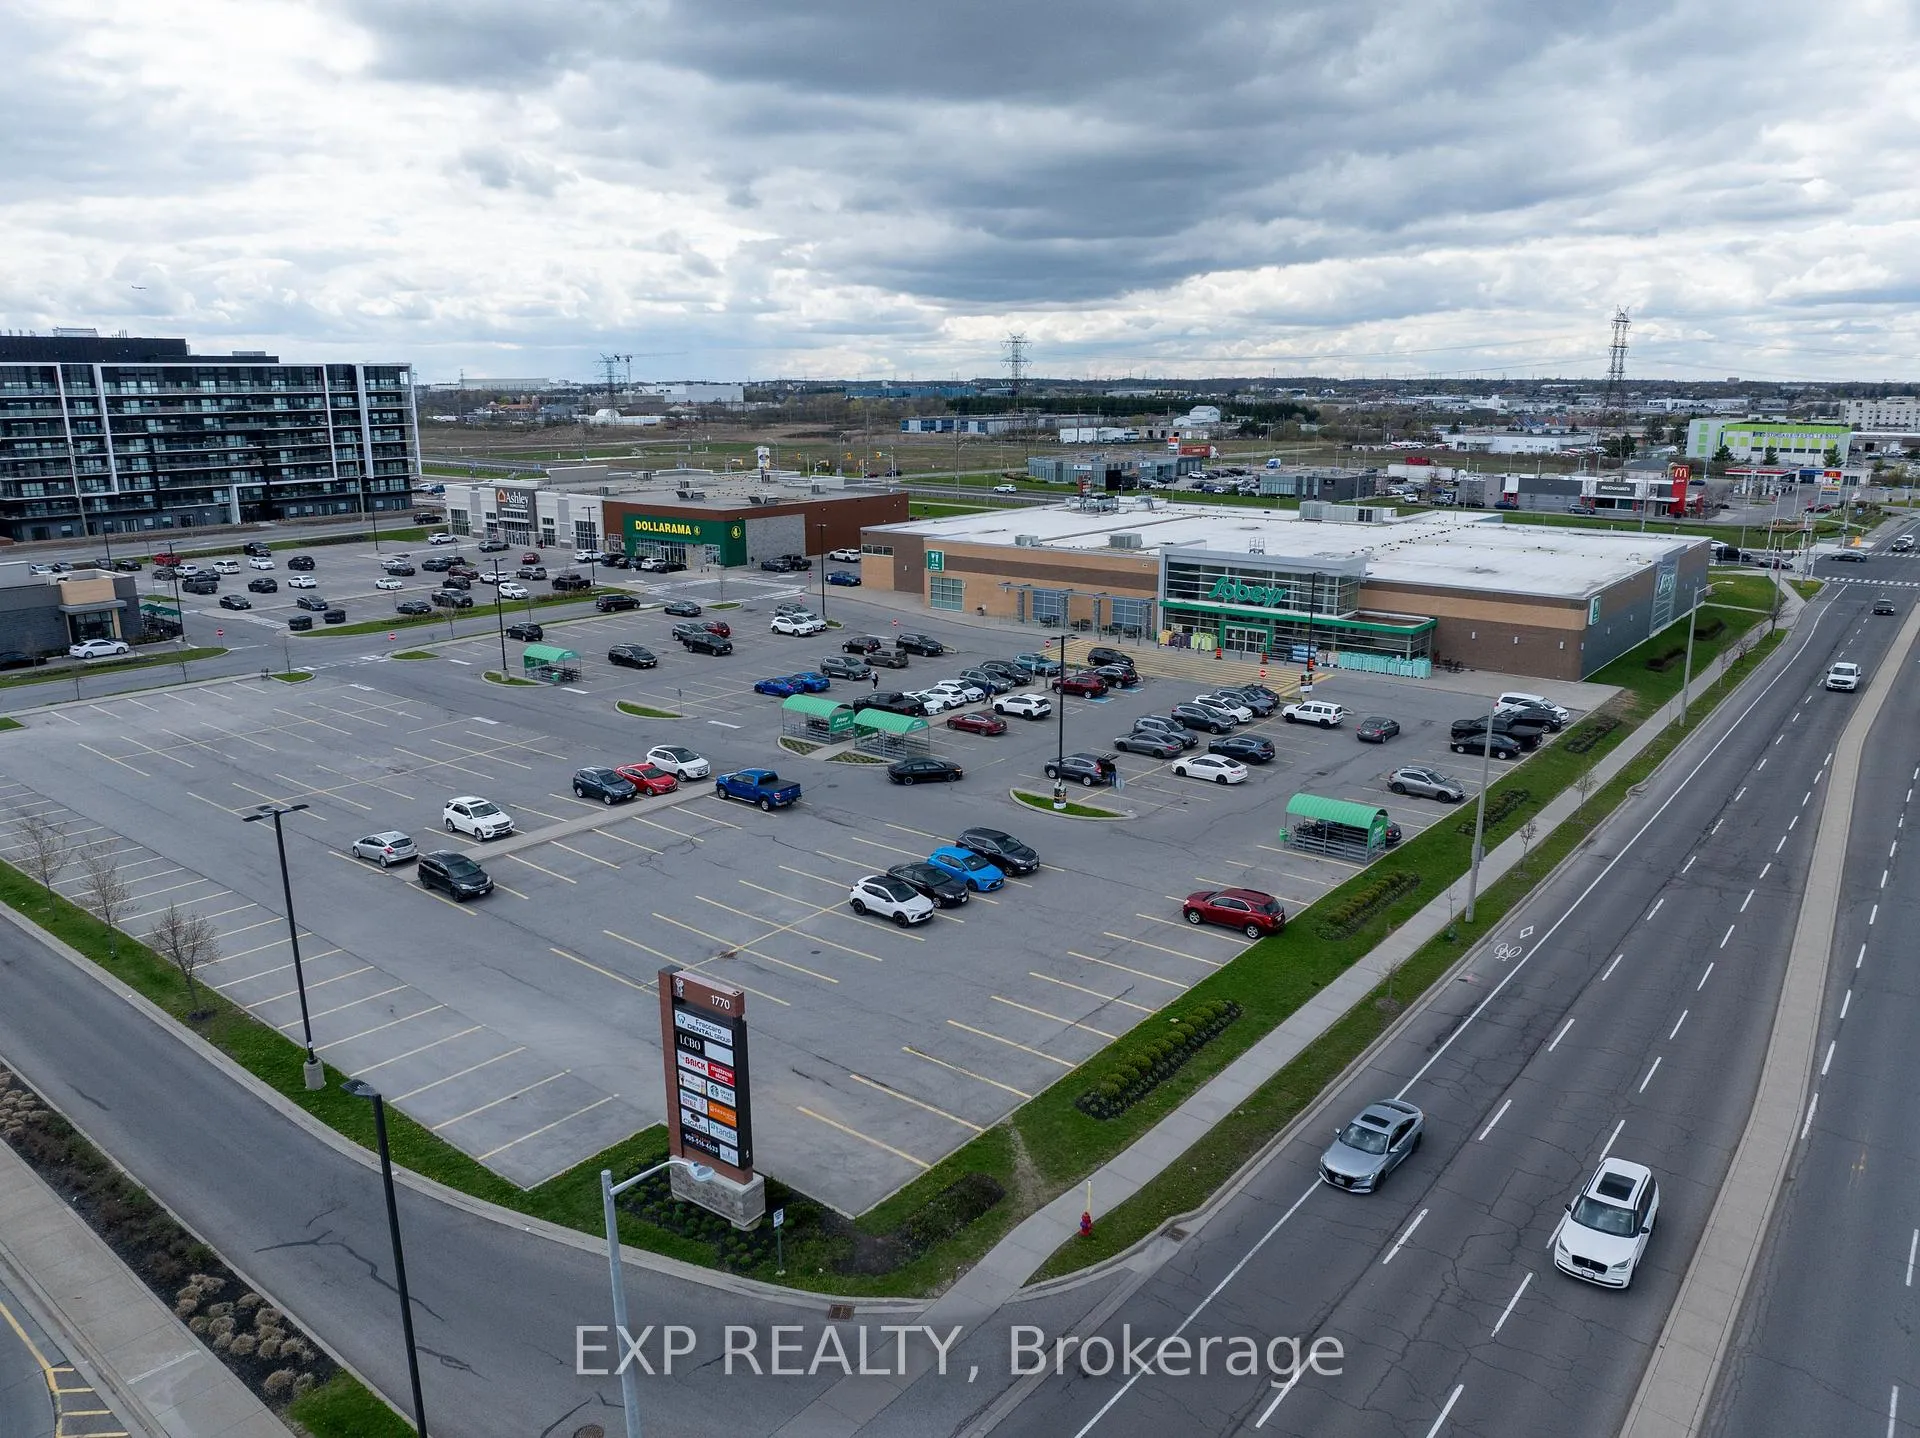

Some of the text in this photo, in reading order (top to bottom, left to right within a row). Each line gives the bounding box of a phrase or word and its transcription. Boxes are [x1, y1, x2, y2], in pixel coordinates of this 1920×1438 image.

[506, 491, 529, 508] Ashley
[635, 520, 692, 535] DOLLARAMA
[1208, 576, 1287, 607] Sobeys
[711, 995, 730, 1010] 1770
[687, 1024, 714, 1038] DENTAL
[680, 1034, 701, 1050] LCBO
[685, 1056, 706, 1071] BRICK
[683, 1117, 708, 1133] CIGARS
